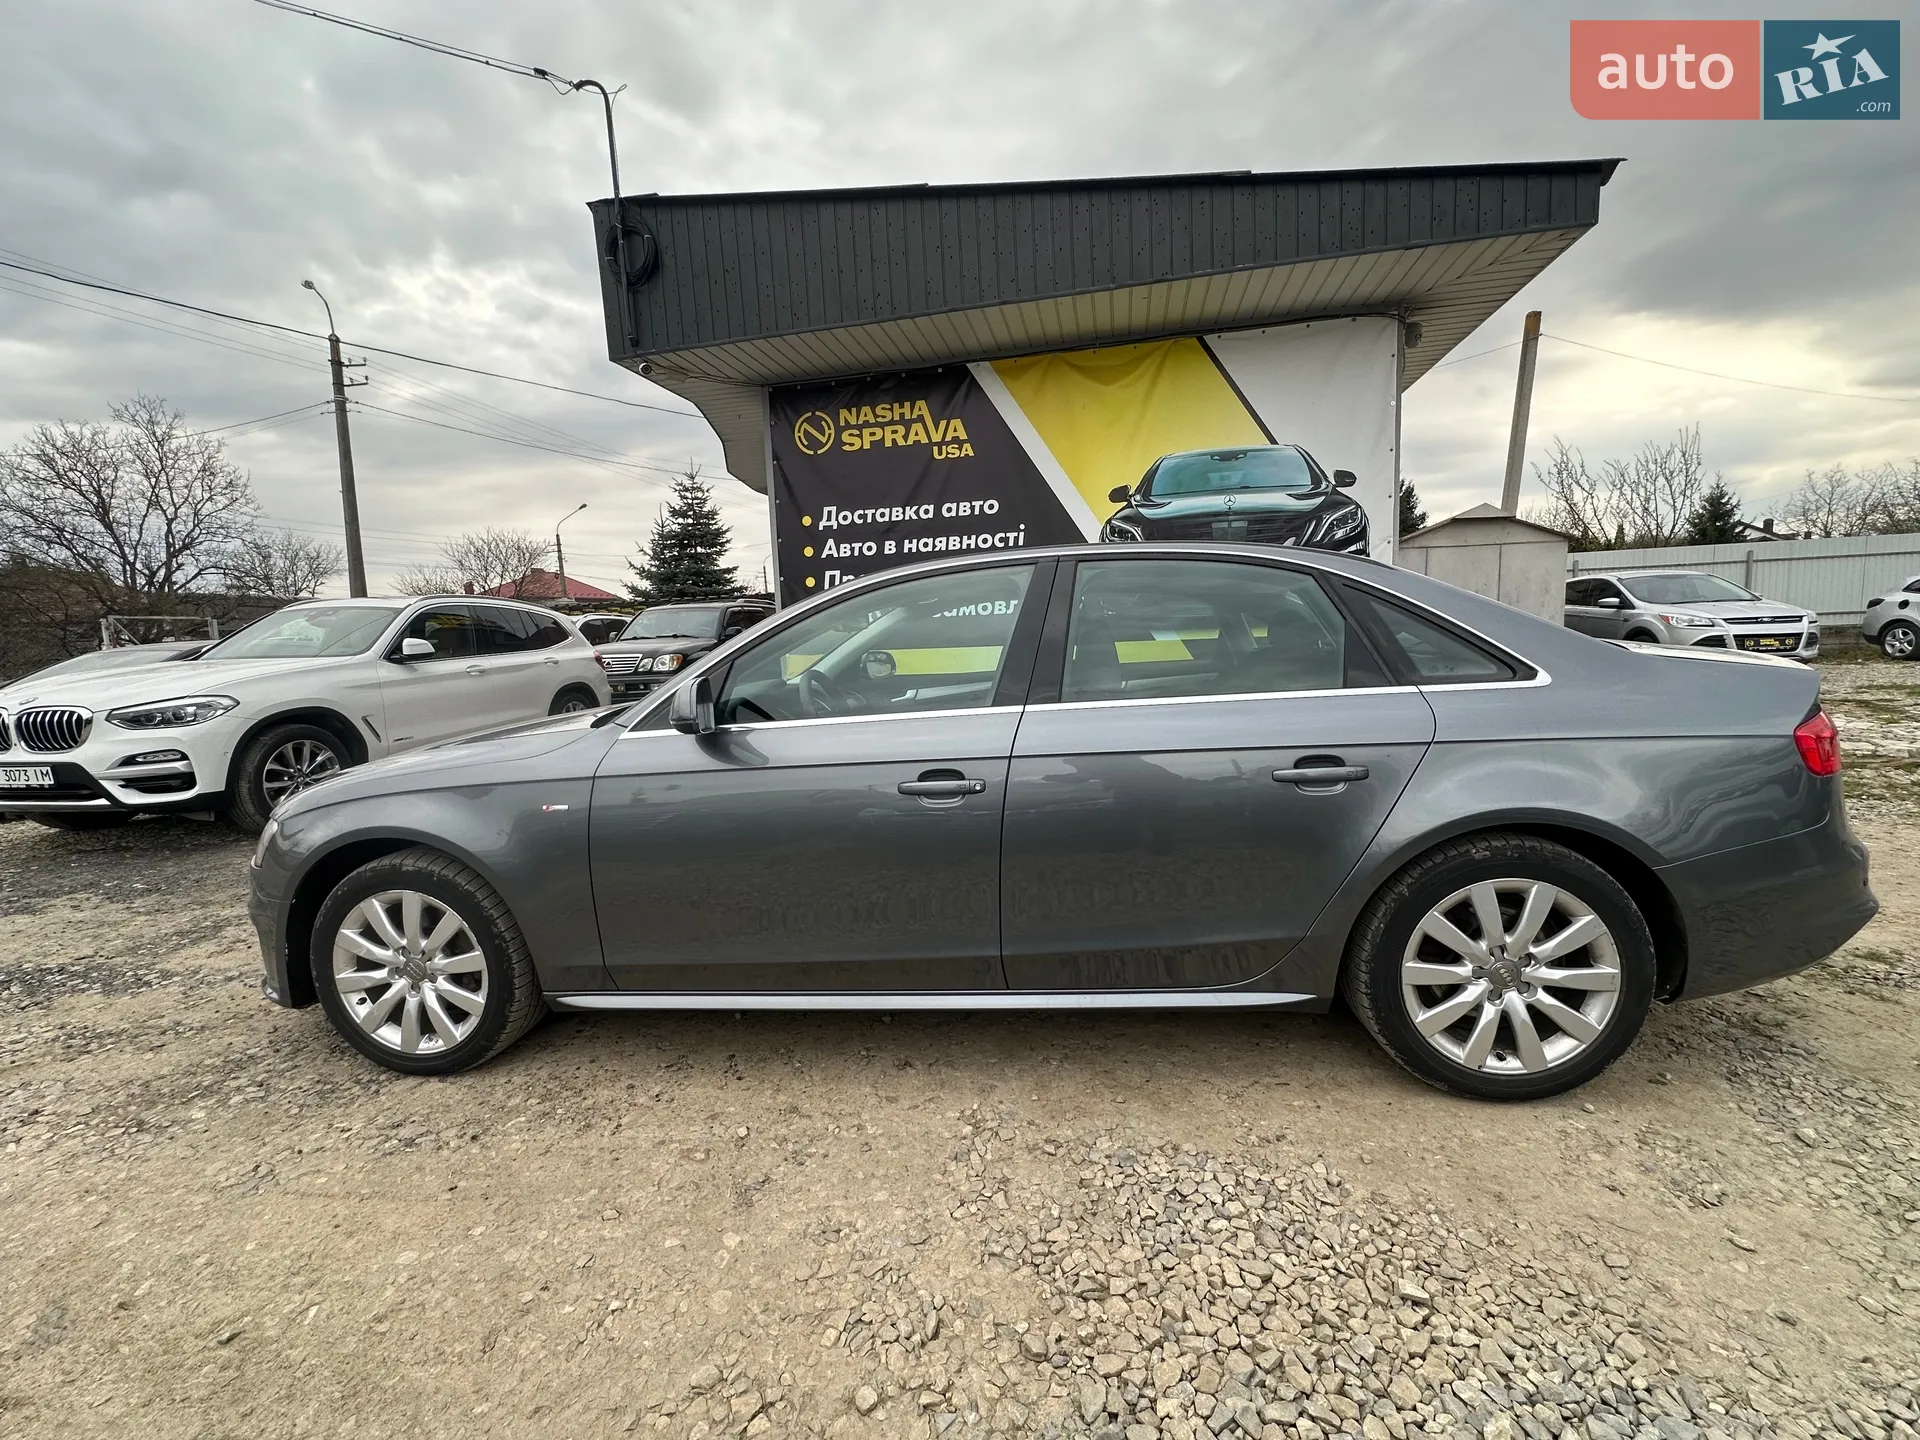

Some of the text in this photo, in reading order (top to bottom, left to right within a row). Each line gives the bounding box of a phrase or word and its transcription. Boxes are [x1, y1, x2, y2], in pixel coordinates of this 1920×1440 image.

[839, 400, 931, 426] NASHA
[841, 418, 968, 451] SPRAVA
[933, 443, 974, 460] USA
[818, 499, 1000, 530] Доставка авто
[821, 524, 1025, 558] Авто в наявності
[2, 769, 30, 782] 3073
